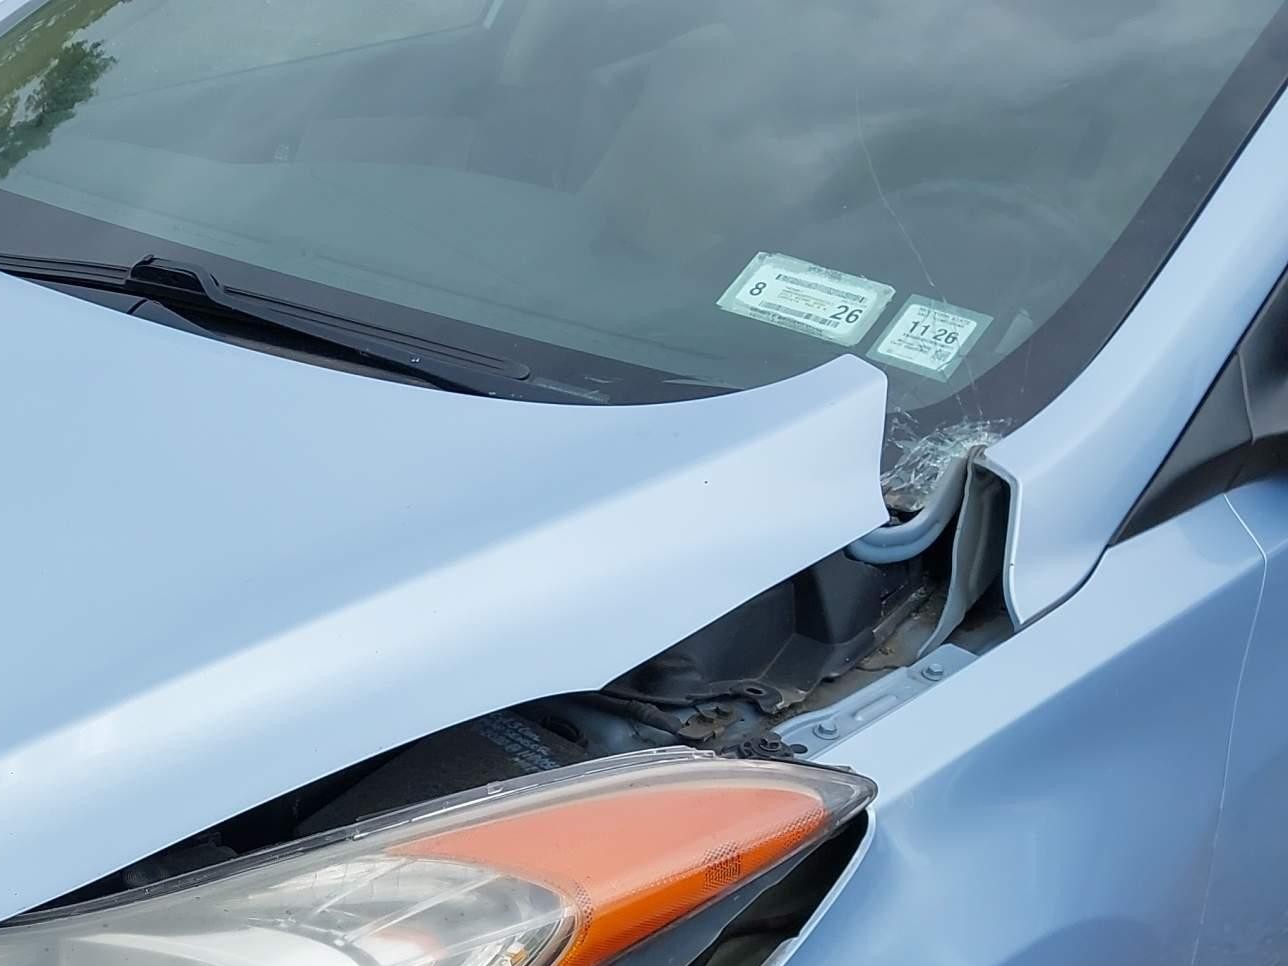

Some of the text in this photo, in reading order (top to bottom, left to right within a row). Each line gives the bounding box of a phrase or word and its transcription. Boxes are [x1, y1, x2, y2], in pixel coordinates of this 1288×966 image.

[749, 281, 767, 296] 8
[829, 304, 863, 324] 26
[909, 320, 930, 336] 11
[932, 328, 959, 344] 26
